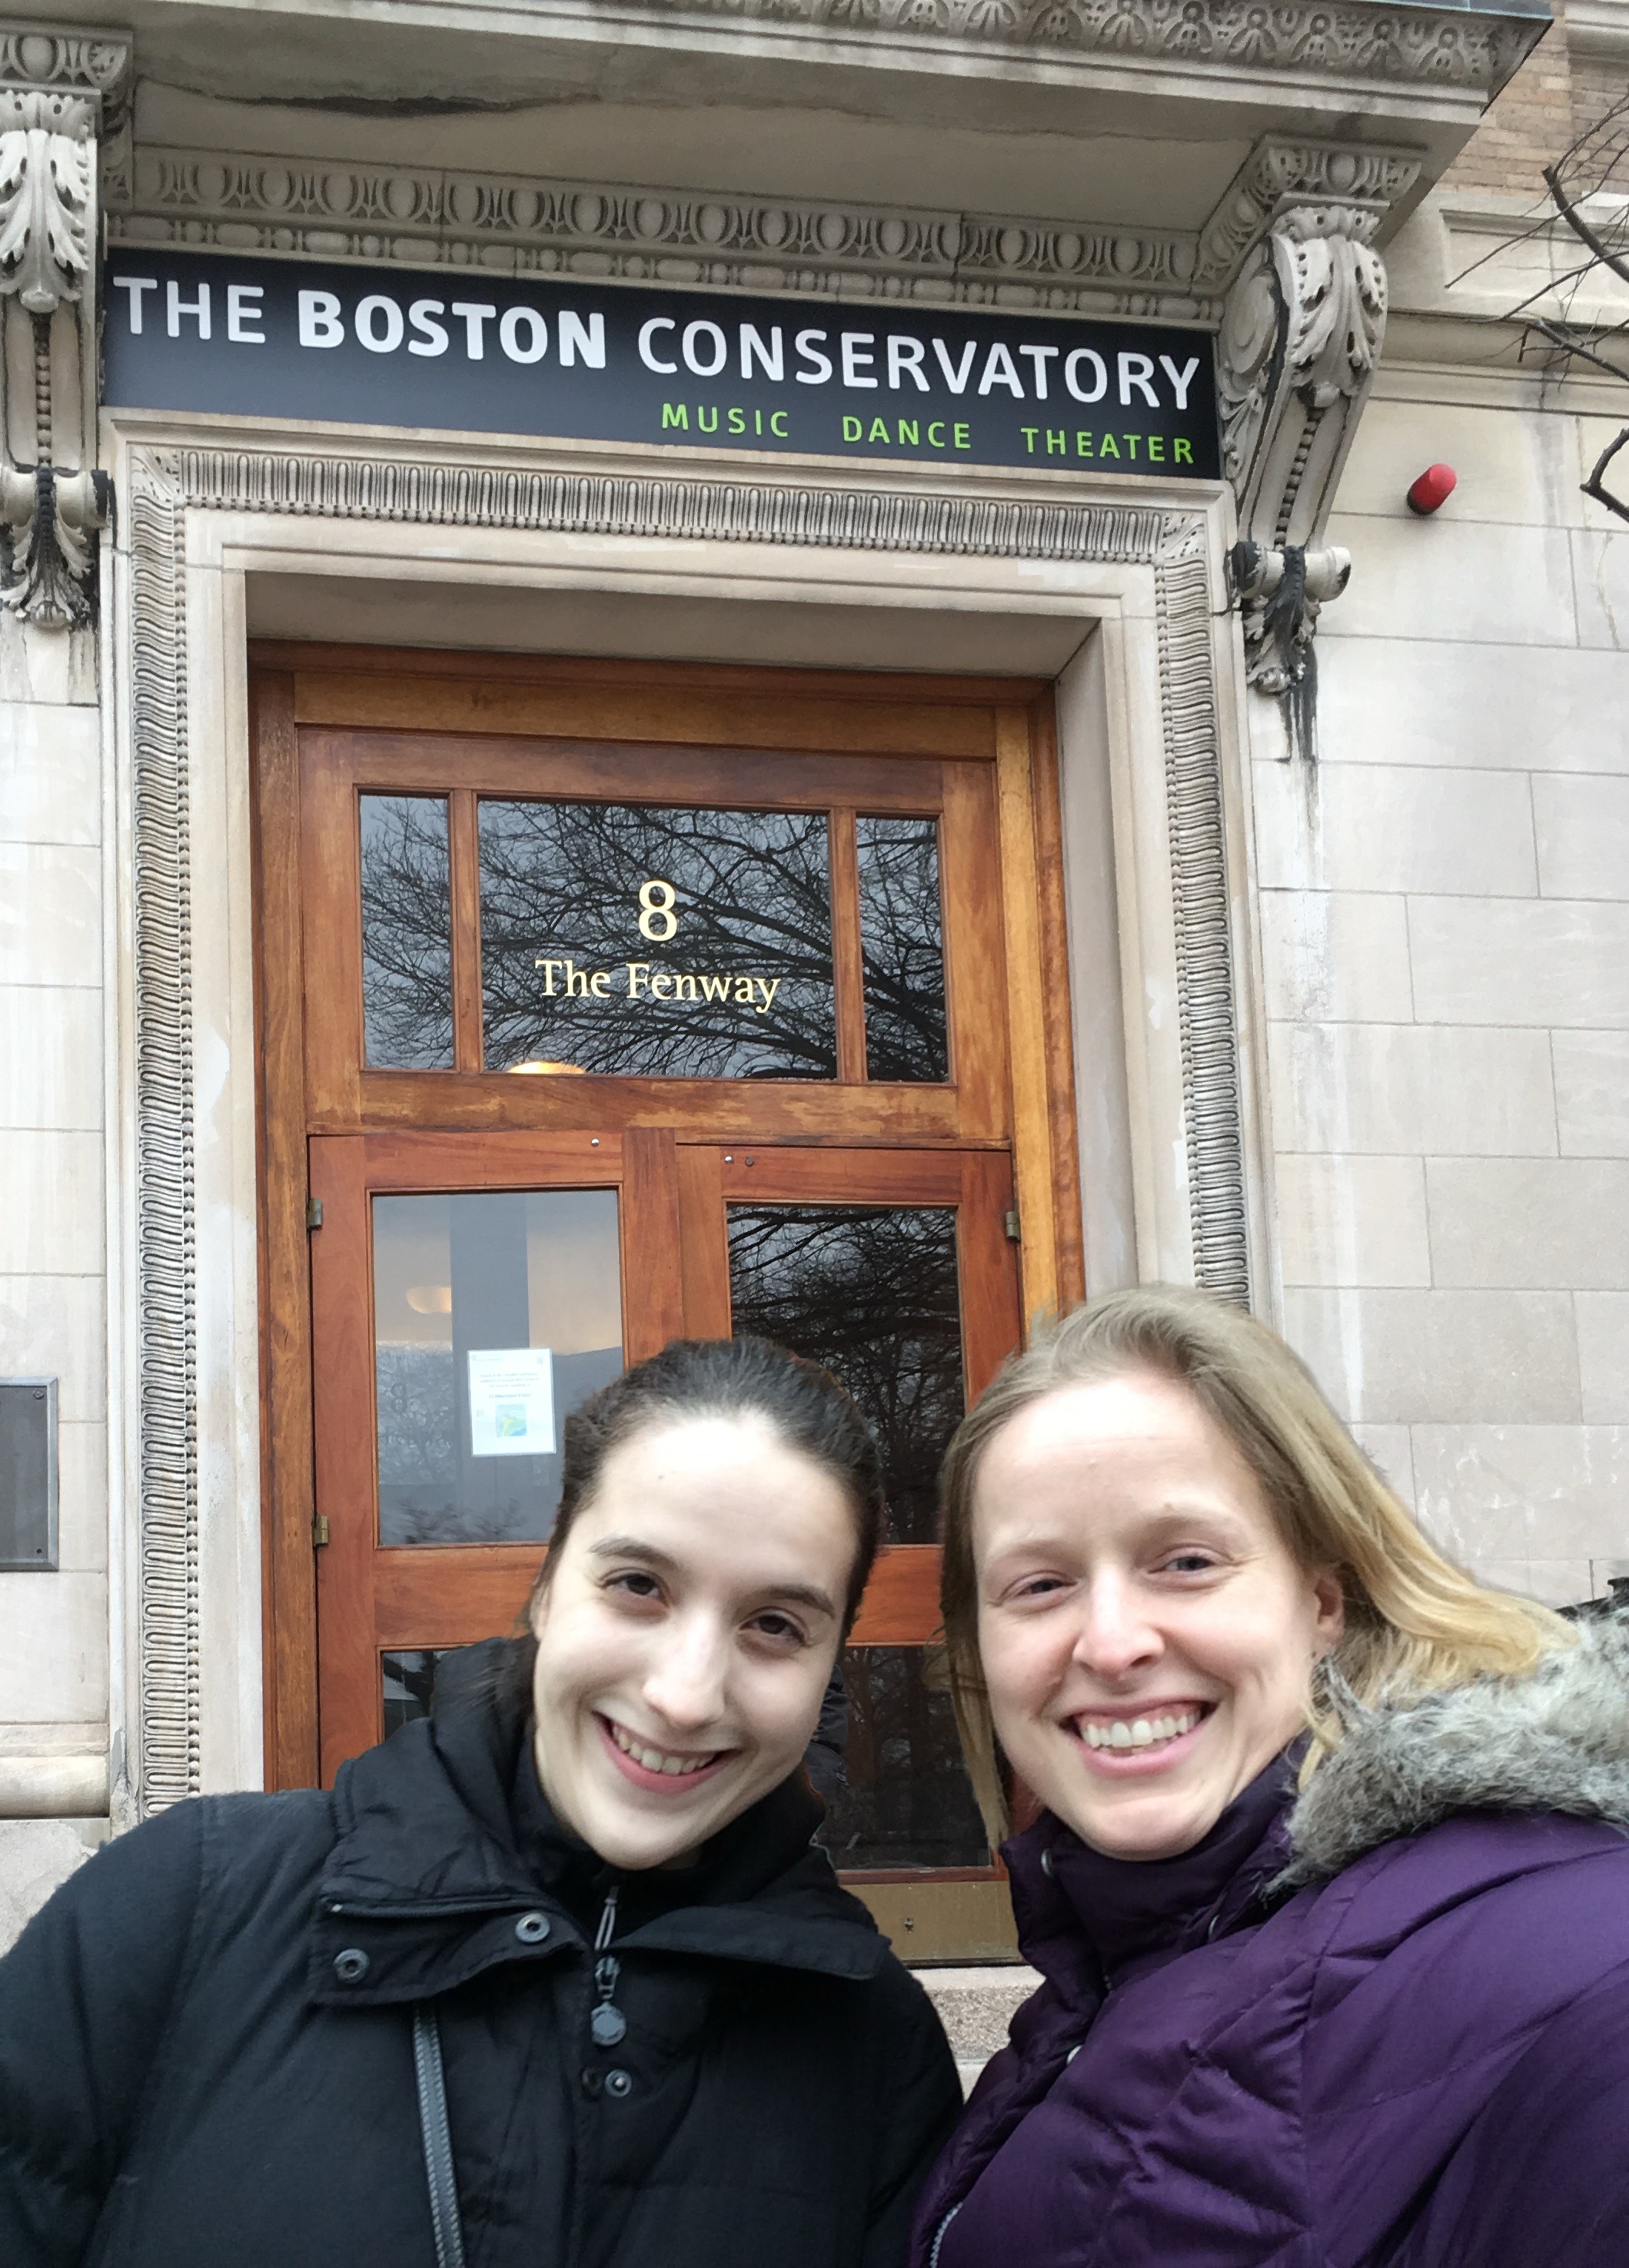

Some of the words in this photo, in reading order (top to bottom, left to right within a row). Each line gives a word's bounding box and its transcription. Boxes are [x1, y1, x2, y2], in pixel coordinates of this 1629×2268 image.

[113, 277, 266, 344] THE
[298, 290, 606, 370] BOSTON
[638, 317, 1199, 410] CONSERVATORY
[662, 403, 790, 437] MUSIC
[843, 416, 971, 449] DANCE
[1021, 427, 1194, 463] THEATER
[638, 880, 677, 941] 8
[535, 959, 610, 998] The
[626, 962, 781, 1013] Fenway
